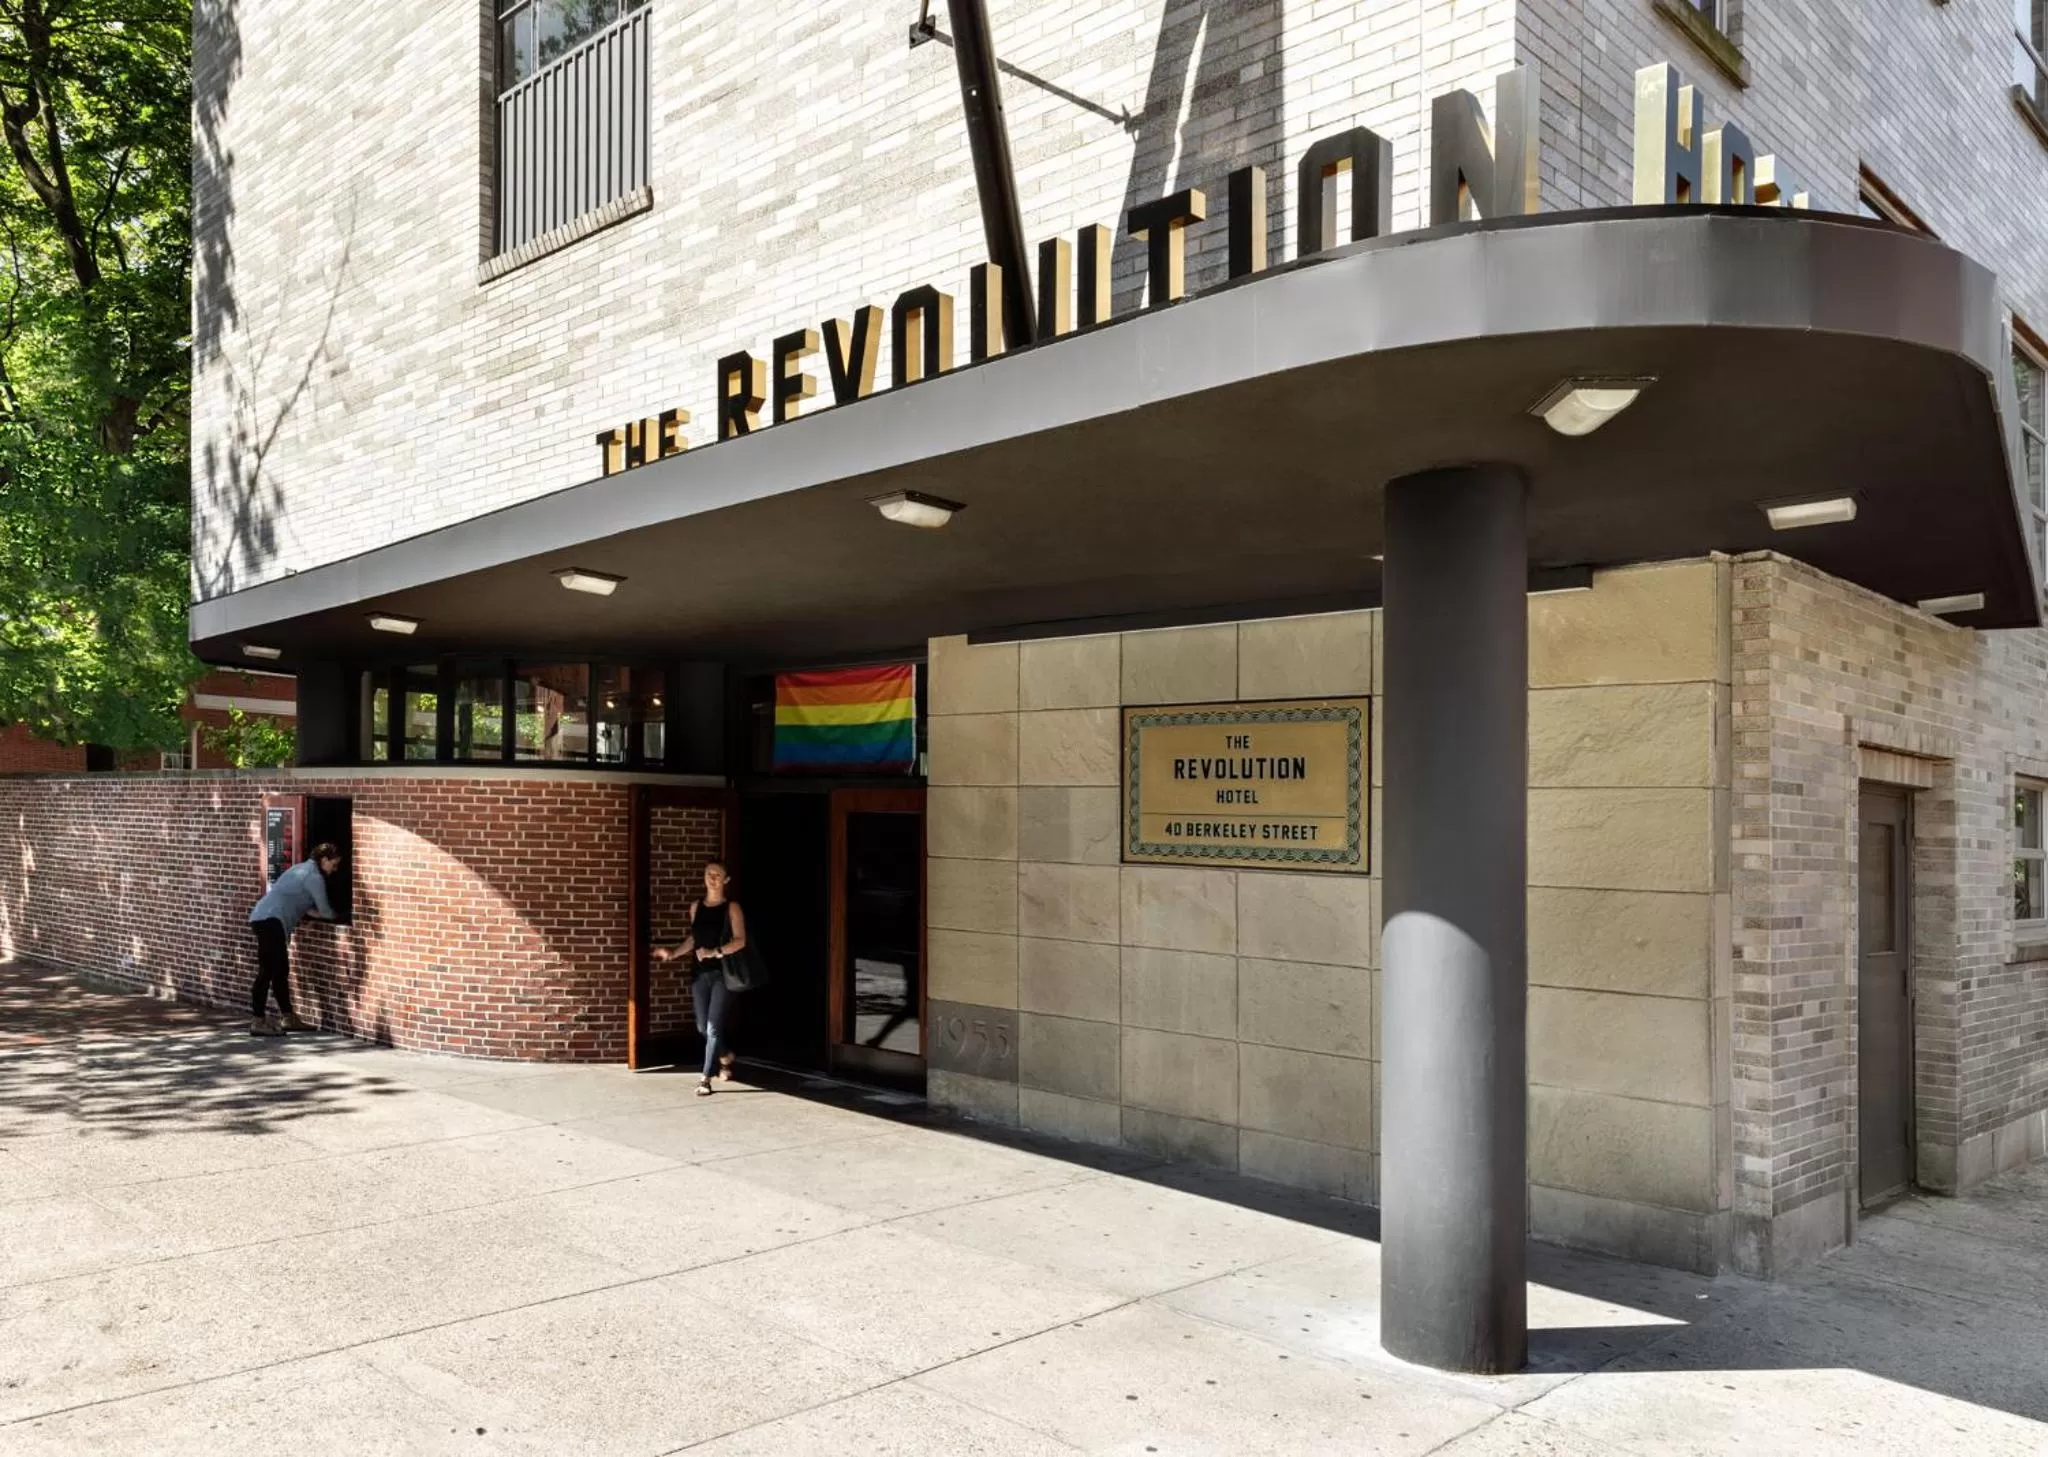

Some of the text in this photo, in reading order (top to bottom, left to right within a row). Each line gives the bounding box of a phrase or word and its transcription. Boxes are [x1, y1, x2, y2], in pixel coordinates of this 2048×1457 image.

[596, 408, 690, 475] THE
[1226, 735, 1250, 749] THE
[1174, 757, 1305, 779] REVOLUTION
[1216, 790, 1258, 804] HOTEL
[1165, 822, 1318, 840] 40 BERKELEY STREET
